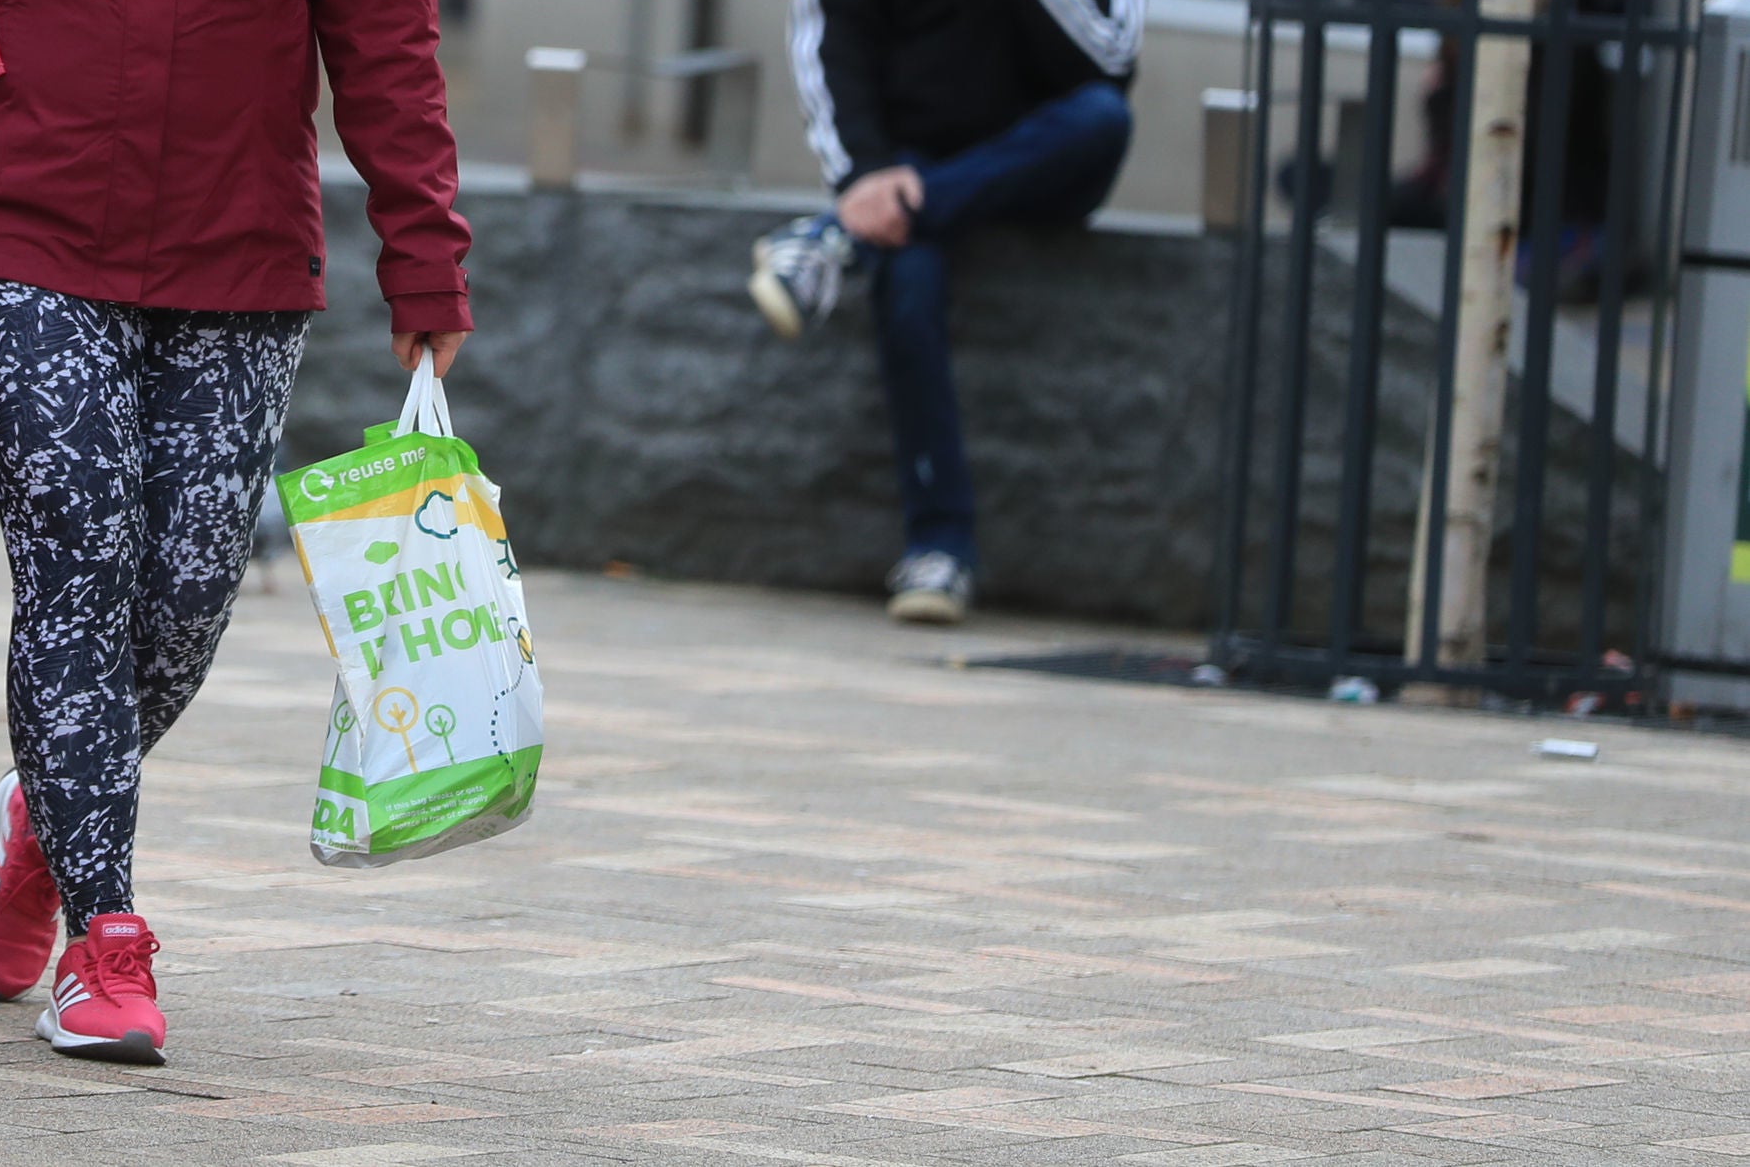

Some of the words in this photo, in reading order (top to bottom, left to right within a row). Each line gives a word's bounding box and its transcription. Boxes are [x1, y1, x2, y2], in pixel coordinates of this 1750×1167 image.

[339, 457, 395, 486] reuse
[400, 446, 426, 467] me
[410, 798, 427, 808] bag
[105, 925, 136, 935] adidas
